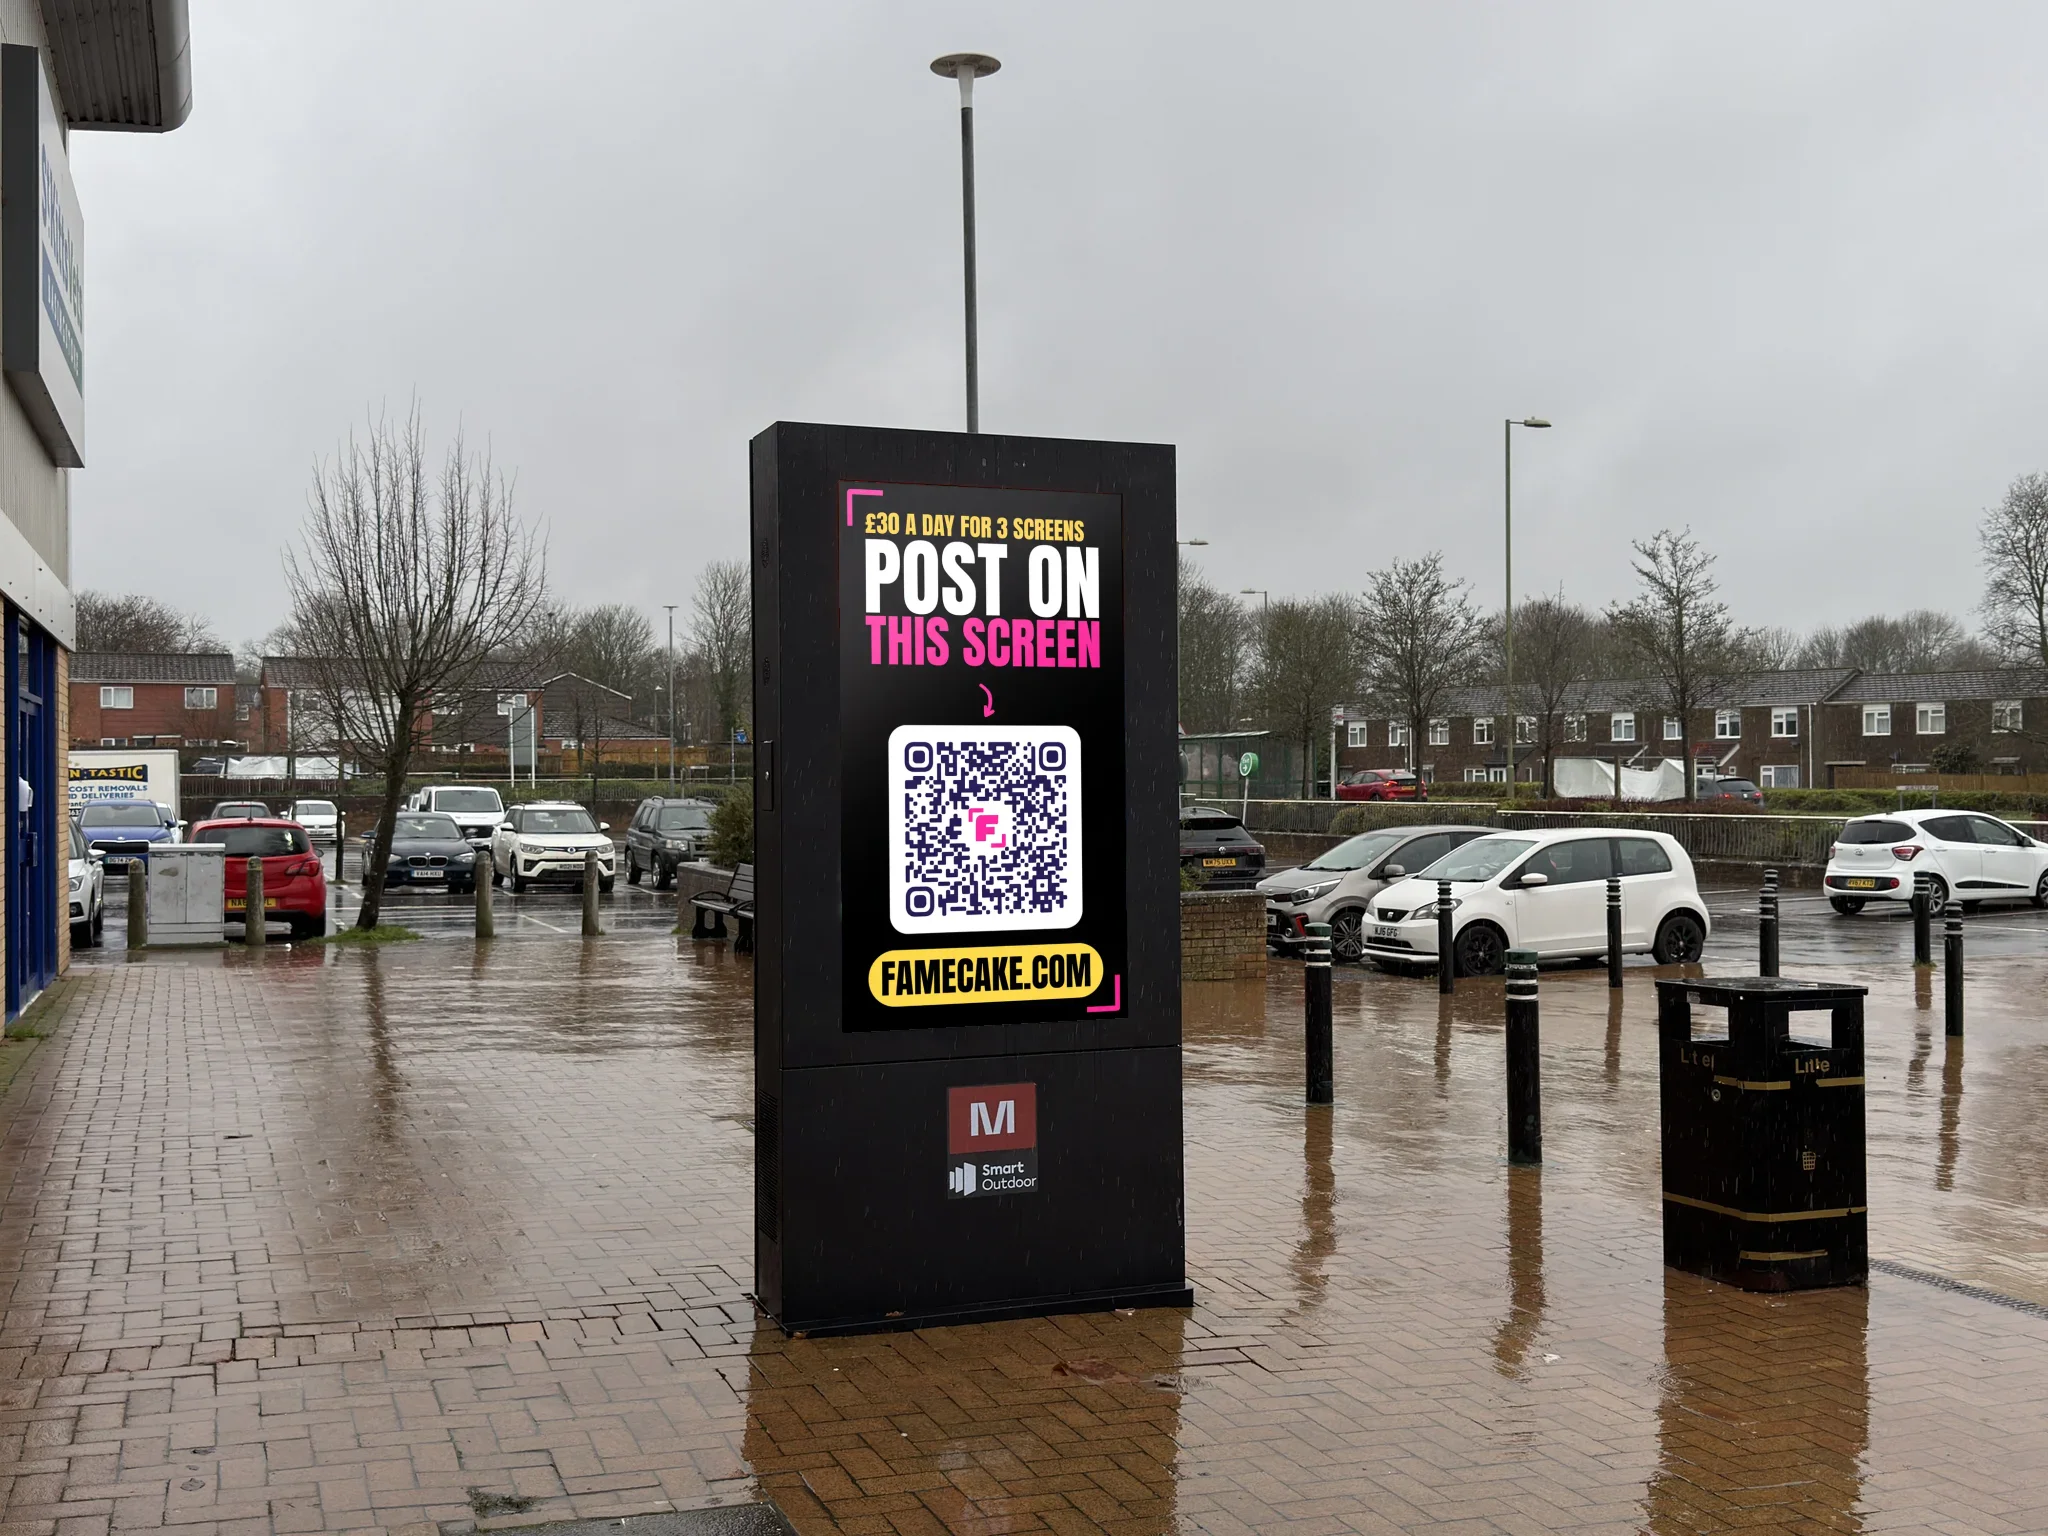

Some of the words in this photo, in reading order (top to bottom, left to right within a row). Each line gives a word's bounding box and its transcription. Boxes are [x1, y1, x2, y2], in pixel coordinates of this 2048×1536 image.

[865, 512, 900, 535] £30
[905, 513, 917, 536] A
[922, 514, 955, 537] DAY
[960, 515, 992, 538] FOR
[996, 517, 1008, 539] 3
[1013, 518, 1085, 542] SCREENS
[865, 538, 1008, 616] POST
[1028, 544, 1100, 619] ON
[865, 615, 950, 667] THIS
[962, 617, 1101, 668] SCREEN
[881, 953, 1092, 997] FAMECAKE.COM
[970, 1100, 1015, 1137] M
[982, 1161, 1025, 1176] Smart
[982, 1175, 1037, 1191] Outdoor
